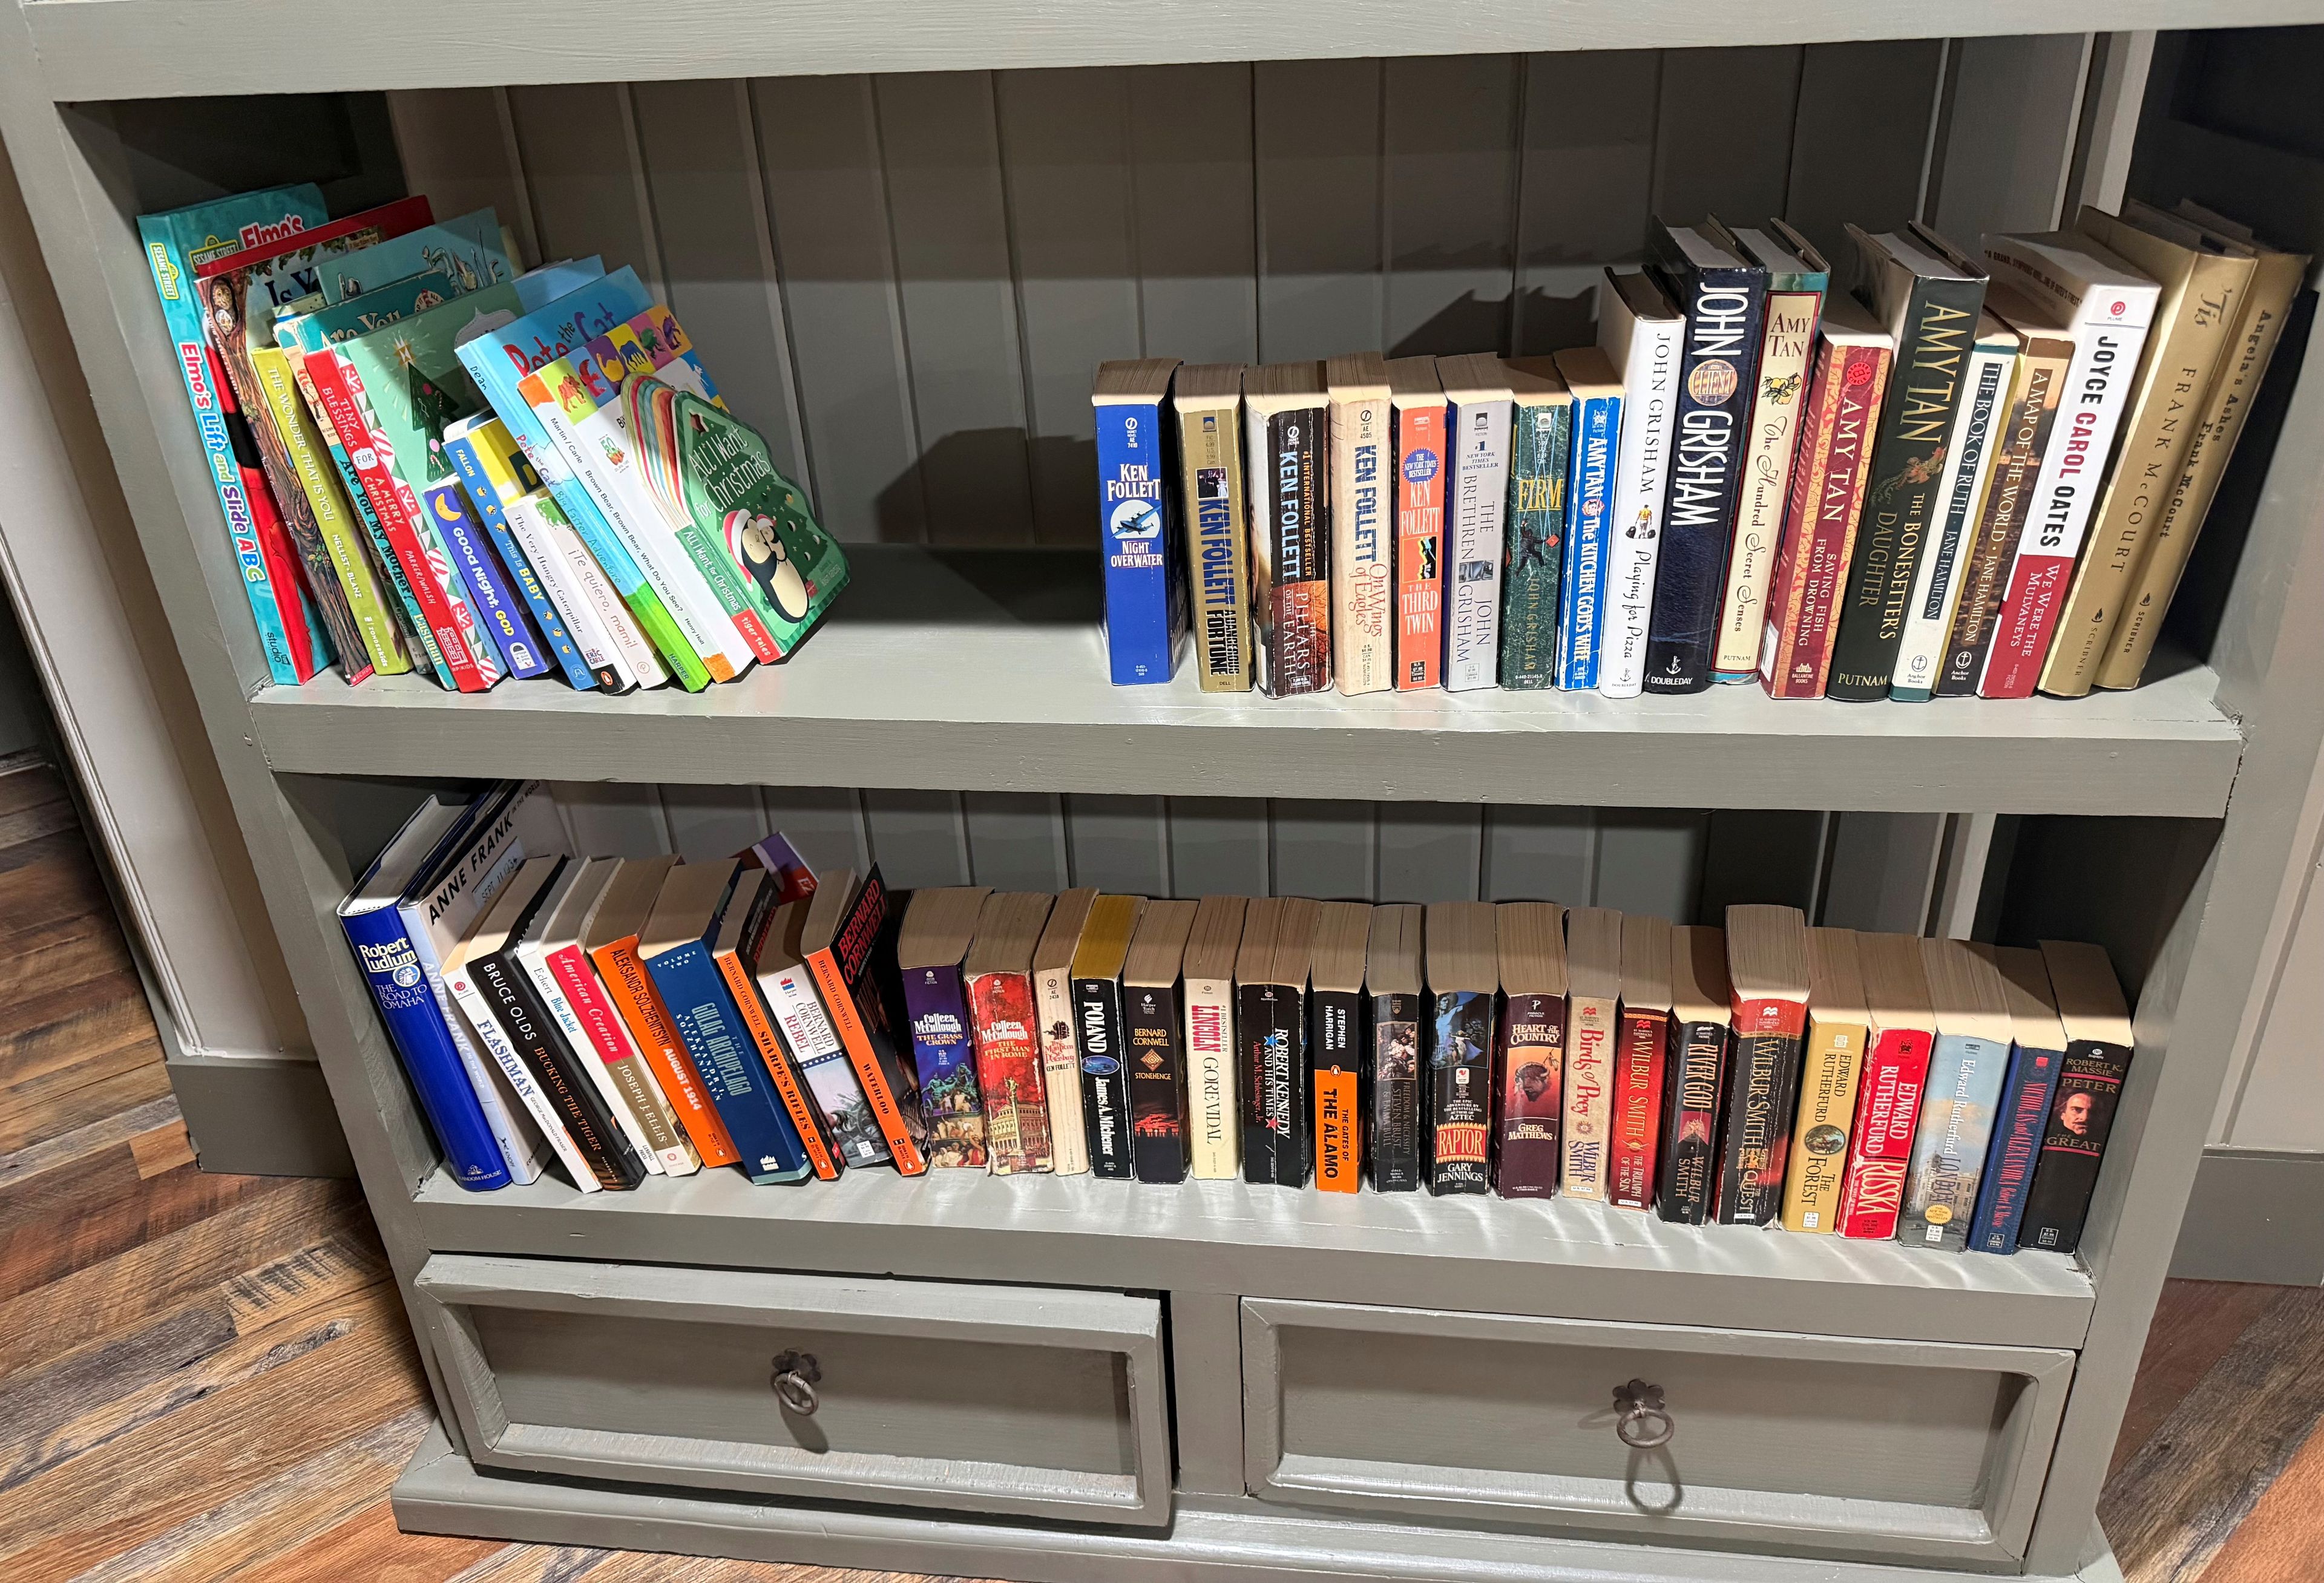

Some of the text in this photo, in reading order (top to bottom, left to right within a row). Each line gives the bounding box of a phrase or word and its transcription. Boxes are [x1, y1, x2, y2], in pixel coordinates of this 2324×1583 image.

[153, 247, 175, 297] SESAME STREET
[1690, 281, 1749, 356] JOHN
[1770, 312, 1810, 333] AMY
[1768, 335, 1804, 358] TAN
[1692, 370, 1737, 396] CLIENT
[1896, 300, 1971, 444] AMY TAN
[323, 387, 357, 447] BLESSINGS
[340, 399, 359, 429] TINY
[1640, 333, 1671, 495] JOHN GRISHAM
[182, 344, 266, 582] Elmo's Lift and Slide ABC
[269, 367, 279, 386] THE
[278, 395, 306, 448] WONDER
[301, 453, 316, 483] THAT
[312, 482, 324, 494] IS
[318, 496, 335, 521] YOU
[356, 453, 375, 465] FOR
[456, 449, 475, 477] FALLON
[2040, 335, 2119, 547] JOYCE CAROL OATES
[1107, 479, 1161, 502] FOLLETT
[1119, 464, 1148, 482] KEN
[1670, 410, 1734, 526] GRISHAM
[1926, 364, 2003, 619] THE BOOK OF RUTH JANE HAMILTON
[2110, 367, 2197, 573] FRANK McCOURT
[364, 476, 396, 532] CHRISTMAS
[382, 489, 405, 525] MERRY
[1410, 481, 1430, 508] KEN
[1461, 475, 1478, 560] BRETHREN
[1480, 501, 1495, 533] THE
[1517, 479, 1563, 510] FIRM
[585, 470, 684, 612] Brown Bear, Brown Bear, What Do You See?
[1401, 508, 1440, 536] FOLLETT
[332, 534, 362, 598] NELLIST BLANZ
[505, 540, 544, 601] This Is BABY
[1121, 540, 1150, 554] NIGHT
[1859, 512, 1899, 607] DAUGHTER
[1879, 493, 1925, 640] THE BONESETTER'S
[405, 550, 436, 604] PARKER/WALSH
[514, 514, 583, 634] The Very Hungry Caterpillar
[1408, 582, 1431, 592] THE
[1798, 539, 1827, 647] FROM DROWNING
[1813, 553, 1837, 632] SAVING FISH
[568, 549, 638, 648] ¡Te quiero, mami!
[1402, 591, 1438, 614] THIRD
[1621, 550, 1652, 659] Playing for Pizza
[2011, 572, 2043, 647] MULVANEYS
[2021, 563, 2061, 657] WE WERE THE
[741, 617, 772, 656] tiger tales
[1405, 612, 1434, 635] TWIN
[1457, 585, 1473, 663] GRISHAM
[1474, 600, 1492, 645] JOHN
[2123, 611, 2145, 654] SCRIBNER
[267, 632, 282, 663] studio
[669, 653, 689, 680] HARPER
[1650, 677, 1693, 686] DOUBLEDAY
[1837, 673, 1888, 687] PUTNAM
[428, 811, 513, 926] ANNE FRANK
[358, 937, 410, 959] Robert
[365, 950, 418, 972] Ludlum
[375, 984, 395, 992] THE
[380, 984, 427, 1001] ROAD TO
[382, 997, 425, 1010] OMAHA
[484, 963, 537, 1041] BRUCE OLDS
[559, 952, 619, 1052] American Creation
[550, 997, 577, 1034] Blue Jacket
[1083, 1001, 1108, 1054] POLAND
[1134, 1028, 1167, 1038] BERNARD
[1191, 1005, 1221, 1053] LINCOLN
[1325, 1005, 1334, 1050] HARRIGAN
[1337, 1009, 1346, 1049] STEPHEN
[476, 1019, 535, 1097] FLASHMAN
[1133, 1038, 1169, 1047] CORNWELL
[534, 1046, 602, 1152] BUCKING THE TIGER
[663, 1047, 702, 1110] AUGUST 1914
[757, 1031, 810, 1130] SHARPE'S RIFLES
[862, 1063, 890, 1115] WATERLOO
[1135, 1072, 1172, 1080] STONEHENGE
[1626, 1040, 1653, 1137] WILBUR SMITH
[1814, 1054, 1837, 1123] RUTHERFURD
[1834, 1054, 1852, 1097] EDWARD
[2062, 1078, 2117, 1094] PETER
[1203, 1057, 1222, 1145] GORE VIDAL
[1943, 1058, 1976, 1156] Edward Rutherfurd
[1323, 1089, 1339, 1179] THE ALAMO
[1438, 1128, 1483, 1156] RAPTOR
[1508, 1130, 1553, 1141] MATTHEWS
[1518, 1123, 1544, 1133] GREG
[2046, 1137, 2101, 1152] GREAT
[1437, 1171, 1483, 1182] JENNINGS
[1447, 1163, 1472, 1175] GARY
[1801, 1157, 1828, 1206] FOREST
[1820, 1173, 1836, 1191] THE
[1855, 1161, 1906, 1215] RUSSKA
[1932, 1157, 1960, 1204] LONDON
